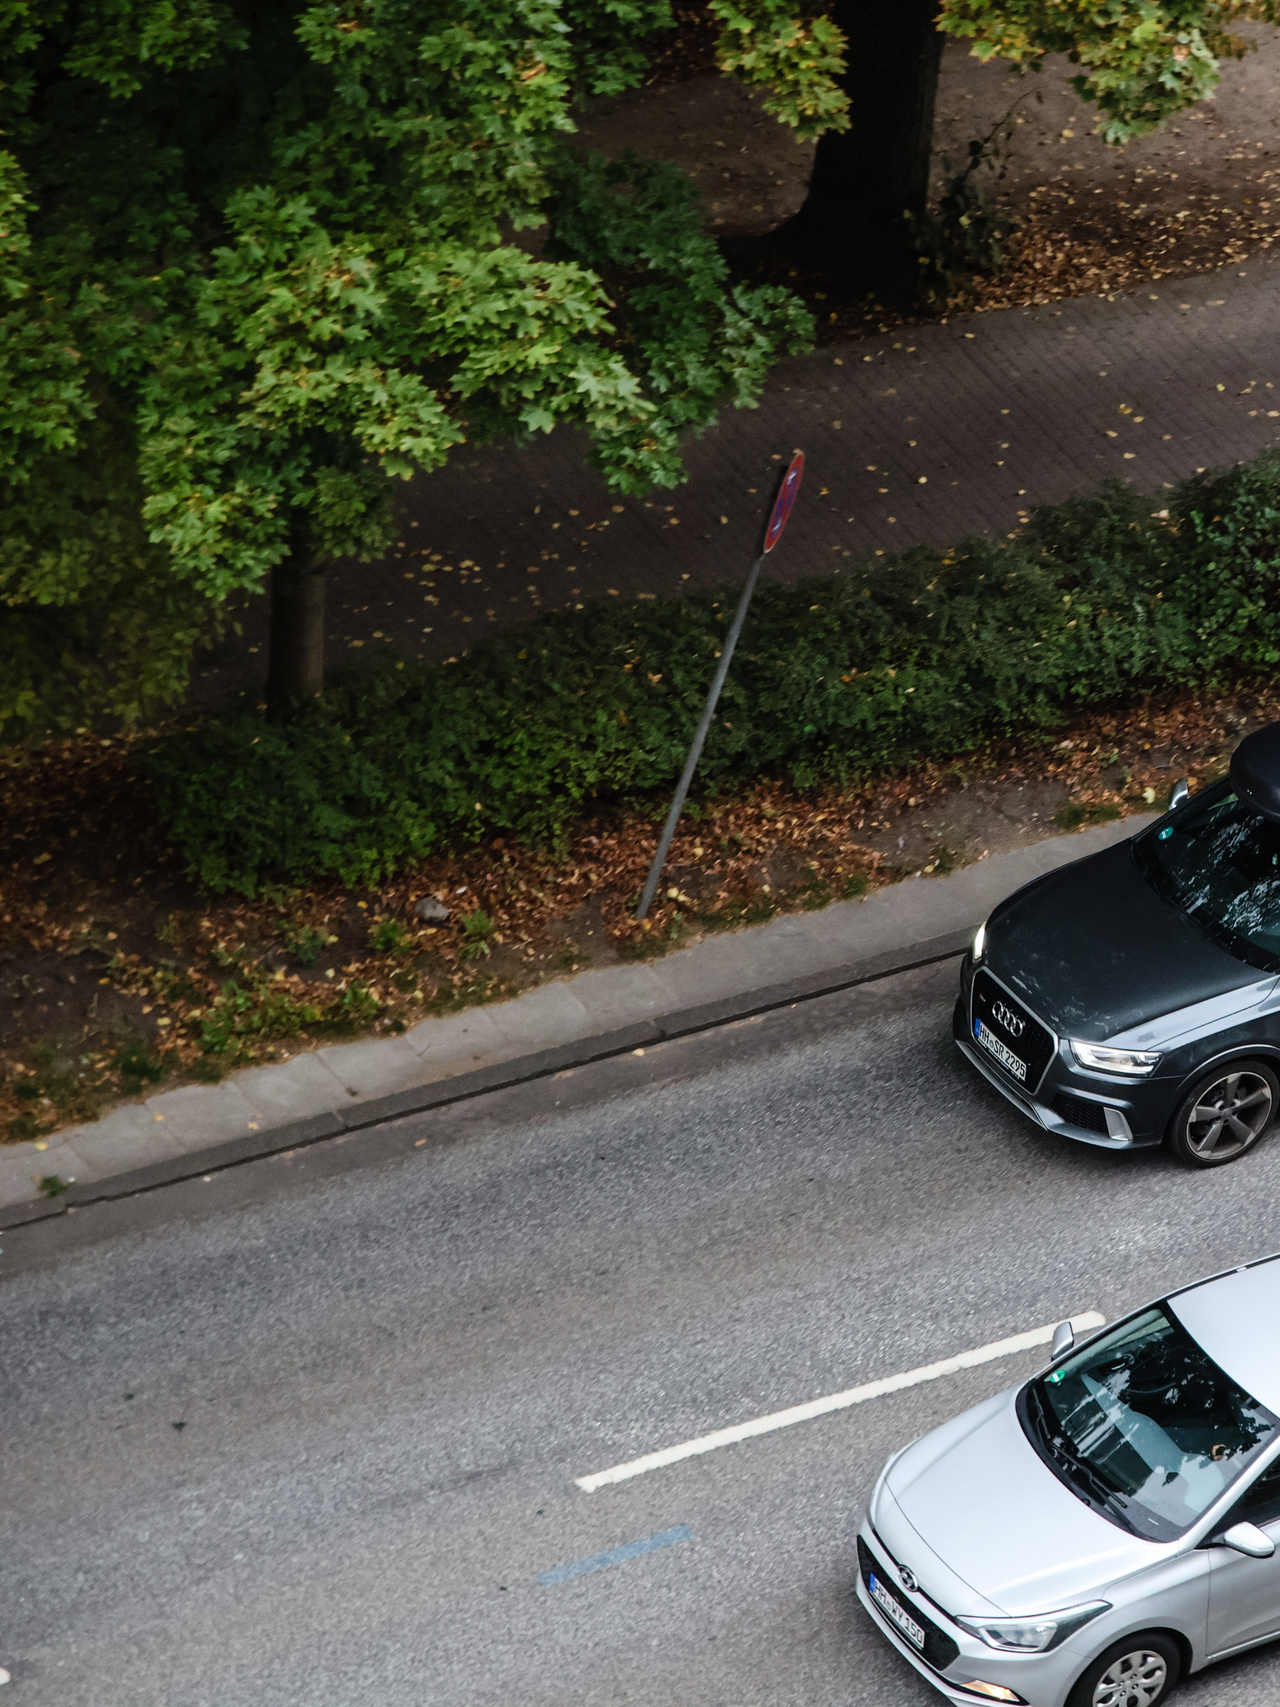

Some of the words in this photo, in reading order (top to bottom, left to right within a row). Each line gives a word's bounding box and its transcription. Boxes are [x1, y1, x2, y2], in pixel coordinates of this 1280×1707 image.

[980, 1026, 990, 1044] HH
[994, 1040, 1005, 1059] SR
[1005, 1051, 1026, 1078] 2295
